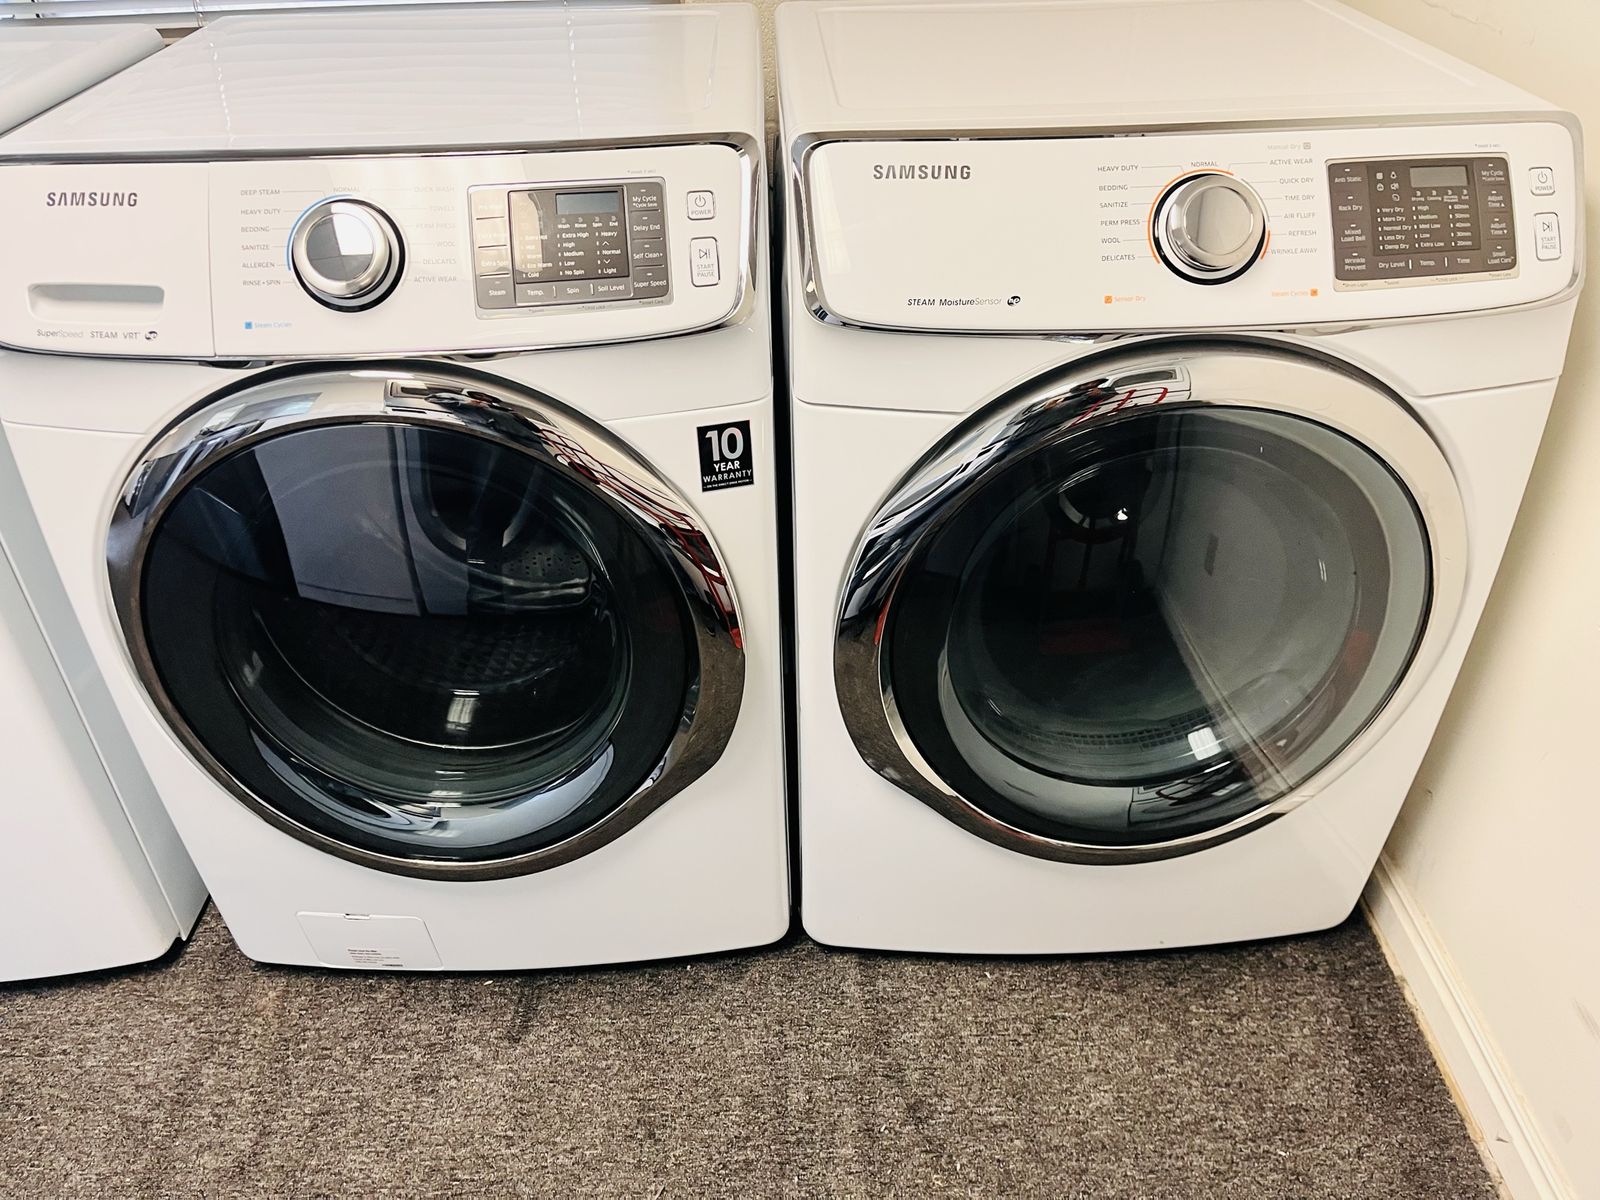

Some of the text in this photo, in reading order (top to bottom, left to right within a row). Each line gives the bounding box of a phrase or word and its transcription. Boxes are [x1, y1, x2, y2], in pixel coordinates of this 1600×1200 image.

[874, 165, 971, 179] SAMSUNG
[46, 192, 138, 207] SAMSUNG
[567, 287, 580, 295] Spin
[908, 298, 936, 306] STEAM
[940, 297, 1001, 306] MoistureSensor
[90, 330, 118, 339] STEAM
[705, 427, 744, 461] 10
[714, 460, 740, 472] YEAR
[703, 469, 752, 483] WARRANTY
